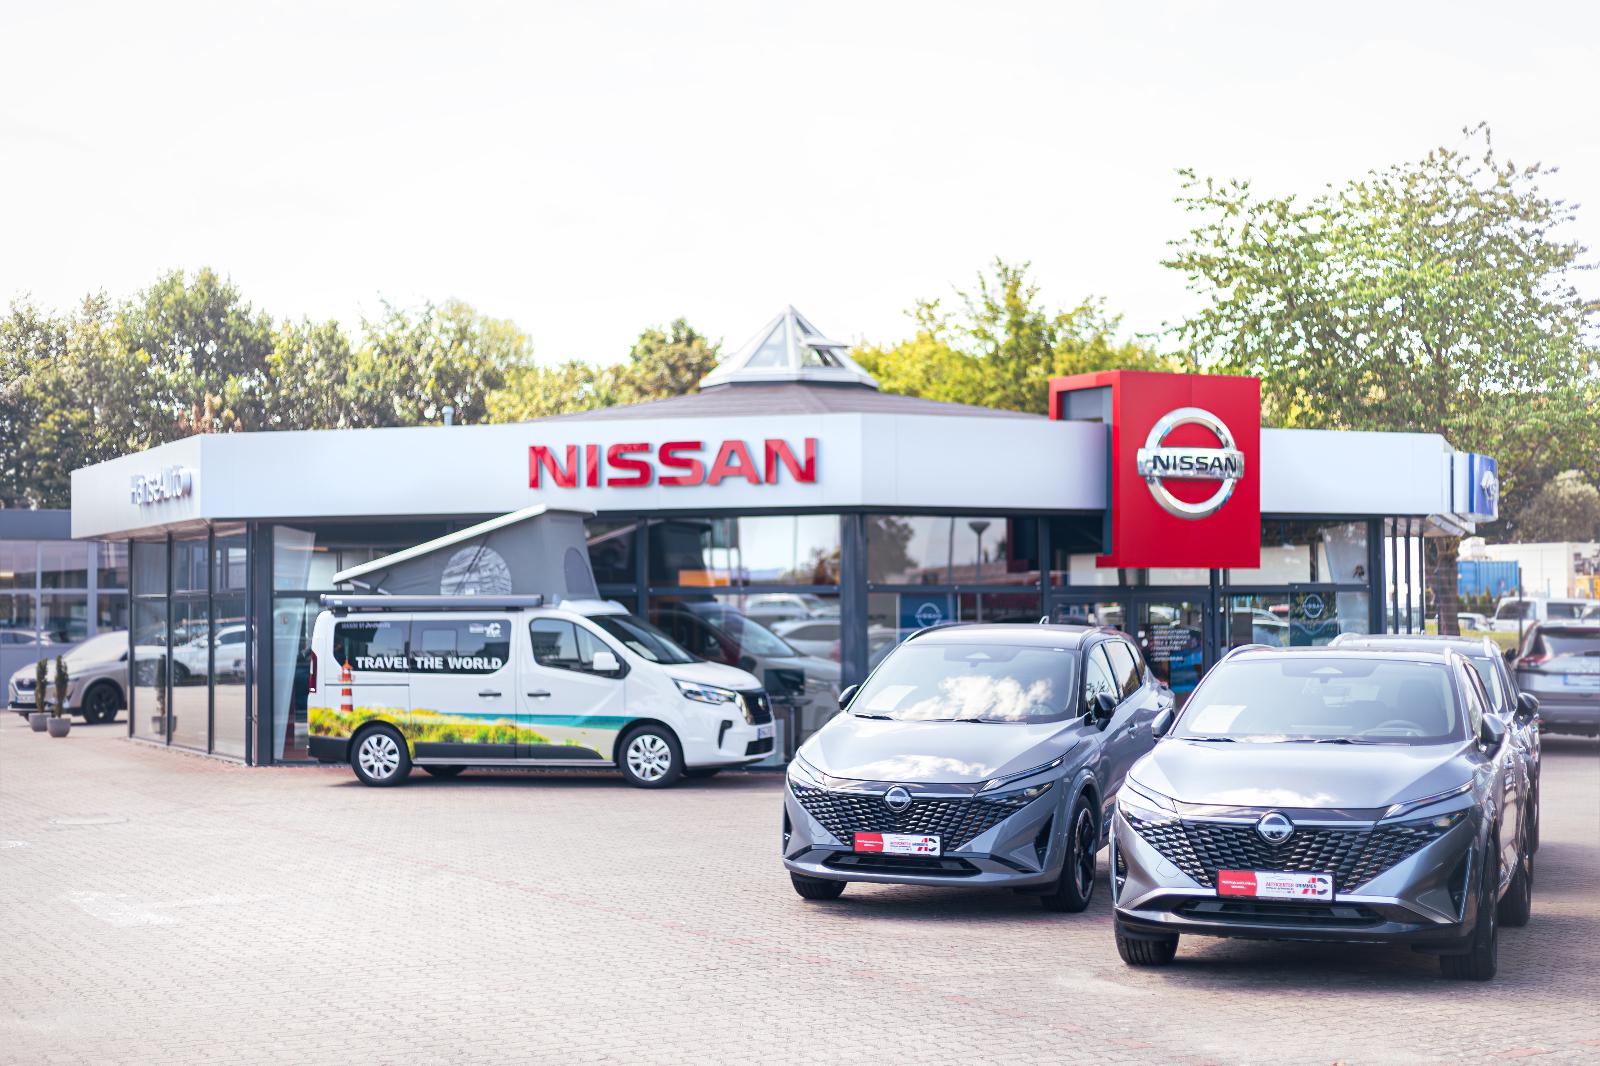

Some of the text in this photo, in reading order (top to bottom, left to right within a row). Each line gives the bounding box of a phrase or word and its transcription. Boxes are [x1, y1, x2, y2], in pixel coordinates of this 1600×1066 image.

[529, 438, 817, 489] NISSAN
[1152, 455, 1237, 472] NISSAN
[355, 656, 502, 670] TRAVEL THE WORLD
